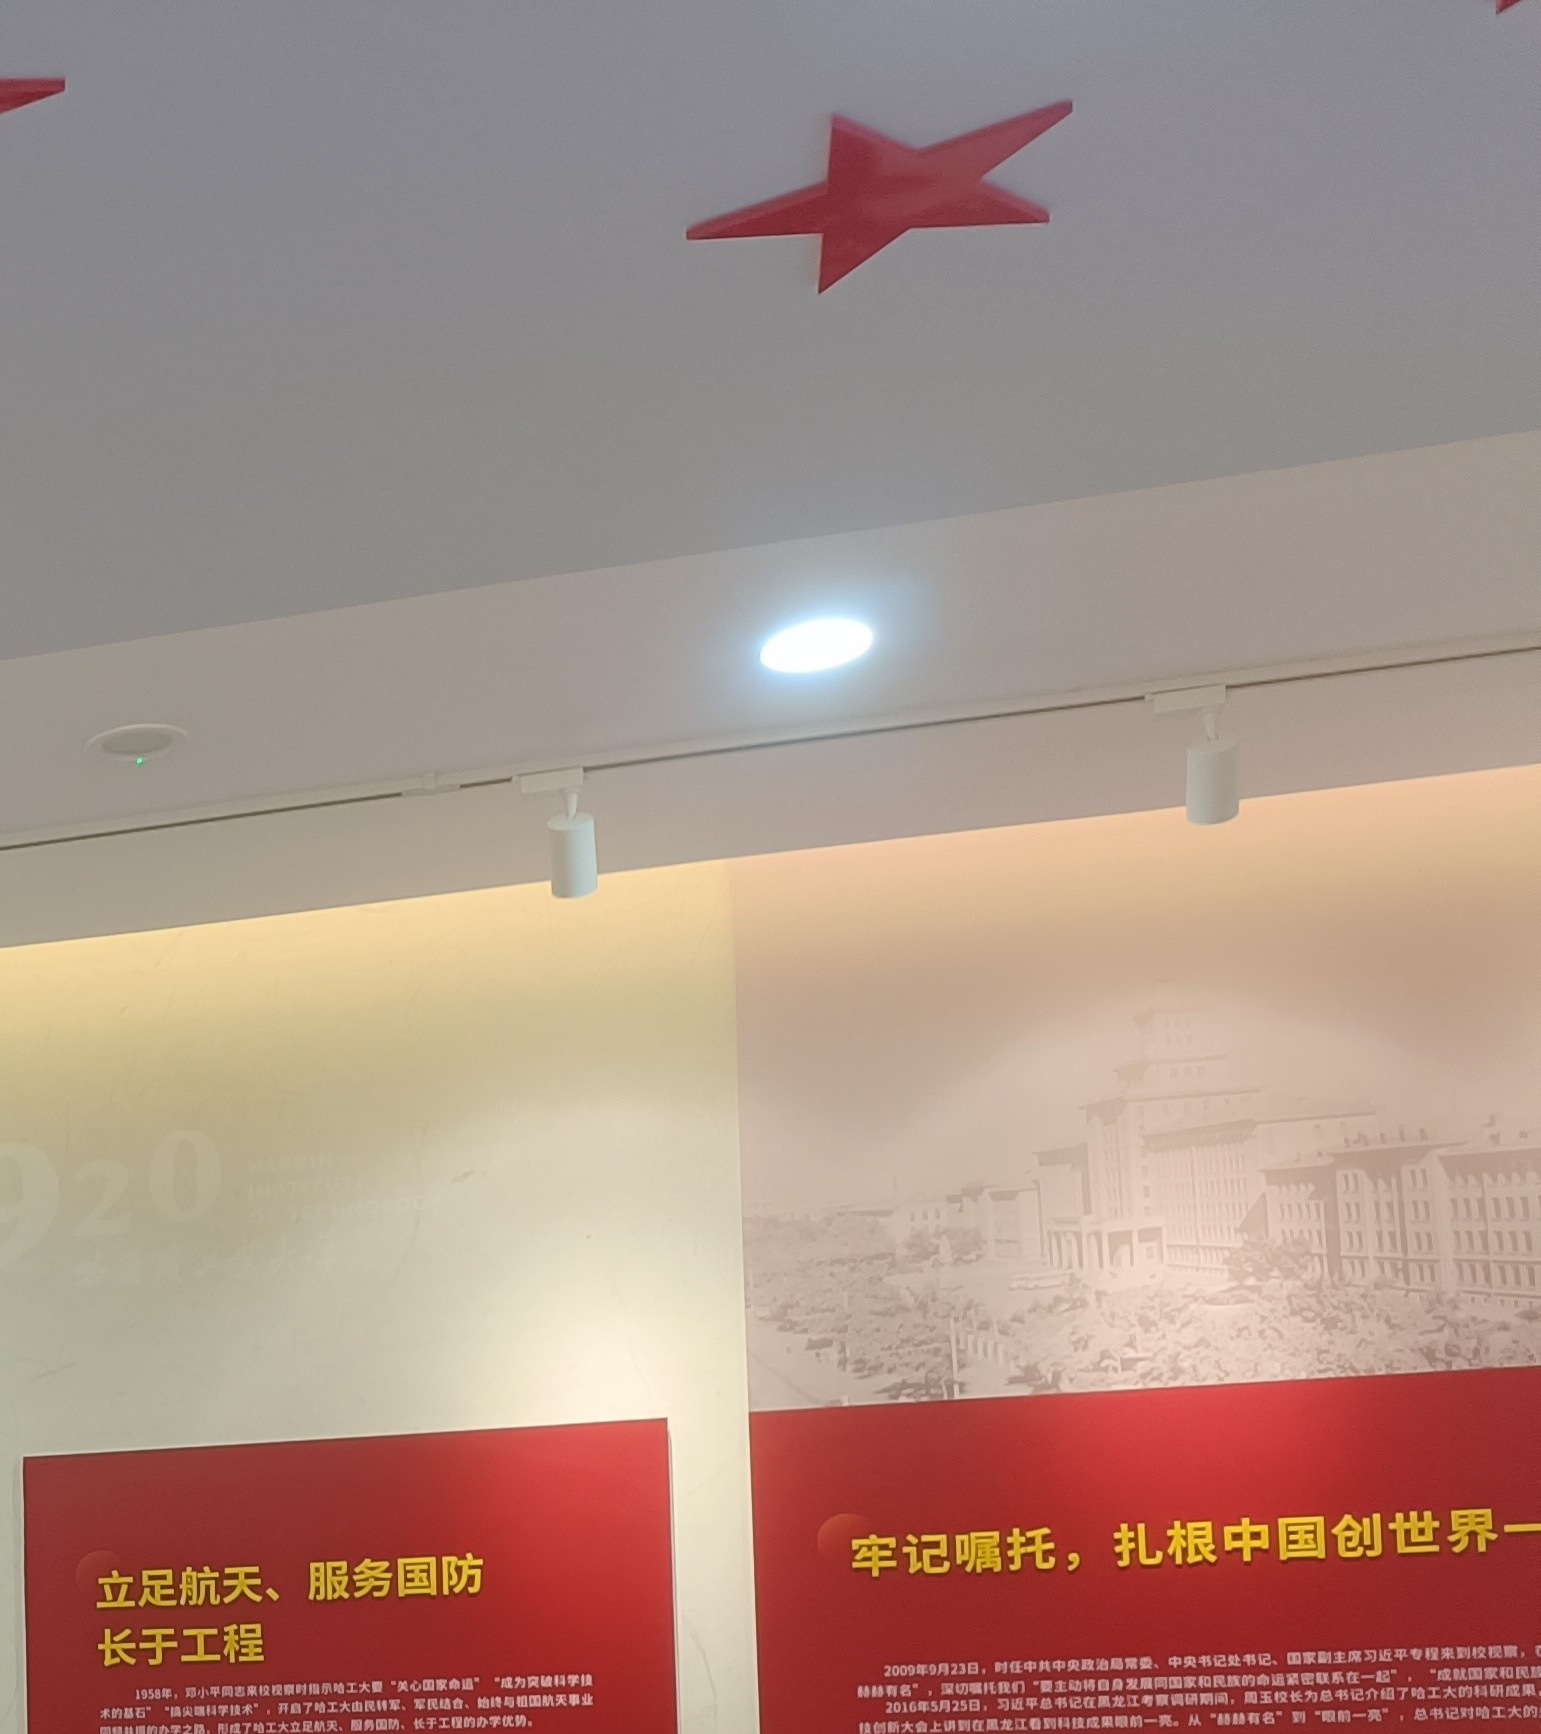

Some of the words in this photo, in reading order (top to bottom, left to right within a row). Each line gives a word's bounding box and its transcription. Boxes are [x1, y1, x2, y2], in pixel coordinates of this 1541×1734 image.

[95, 1552, 485, 1609] 立足航天、服务国防
[97, 1622, 265, 1667] 长于工程
